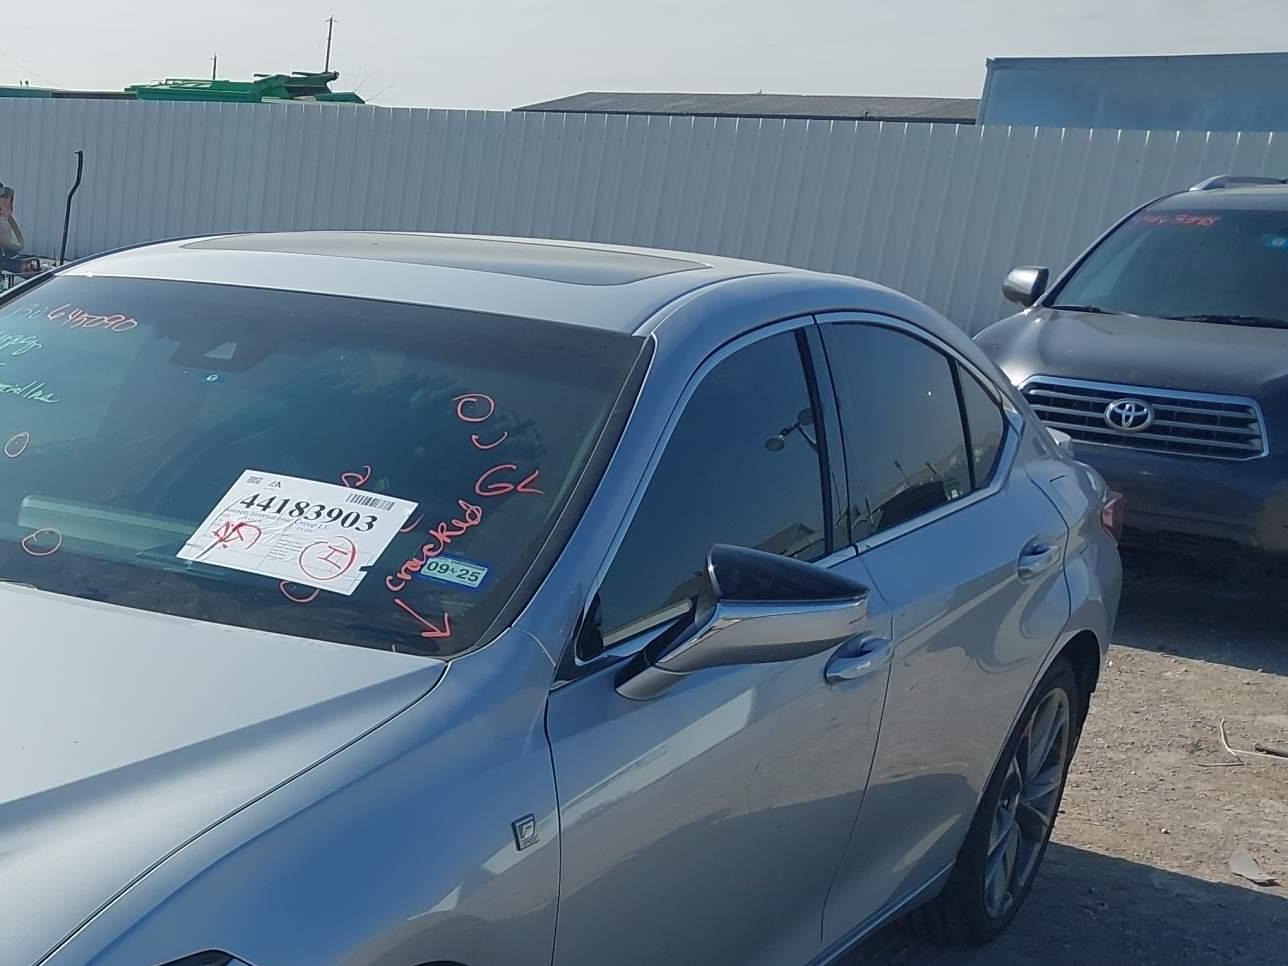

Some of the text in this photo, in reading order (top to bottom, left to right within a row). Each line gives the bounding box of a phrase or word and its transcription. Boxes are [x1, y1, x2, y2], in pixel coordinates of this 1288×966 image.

[239, 492, 379, 533] 44183903
[426, 559, 481, 583] 09 25
